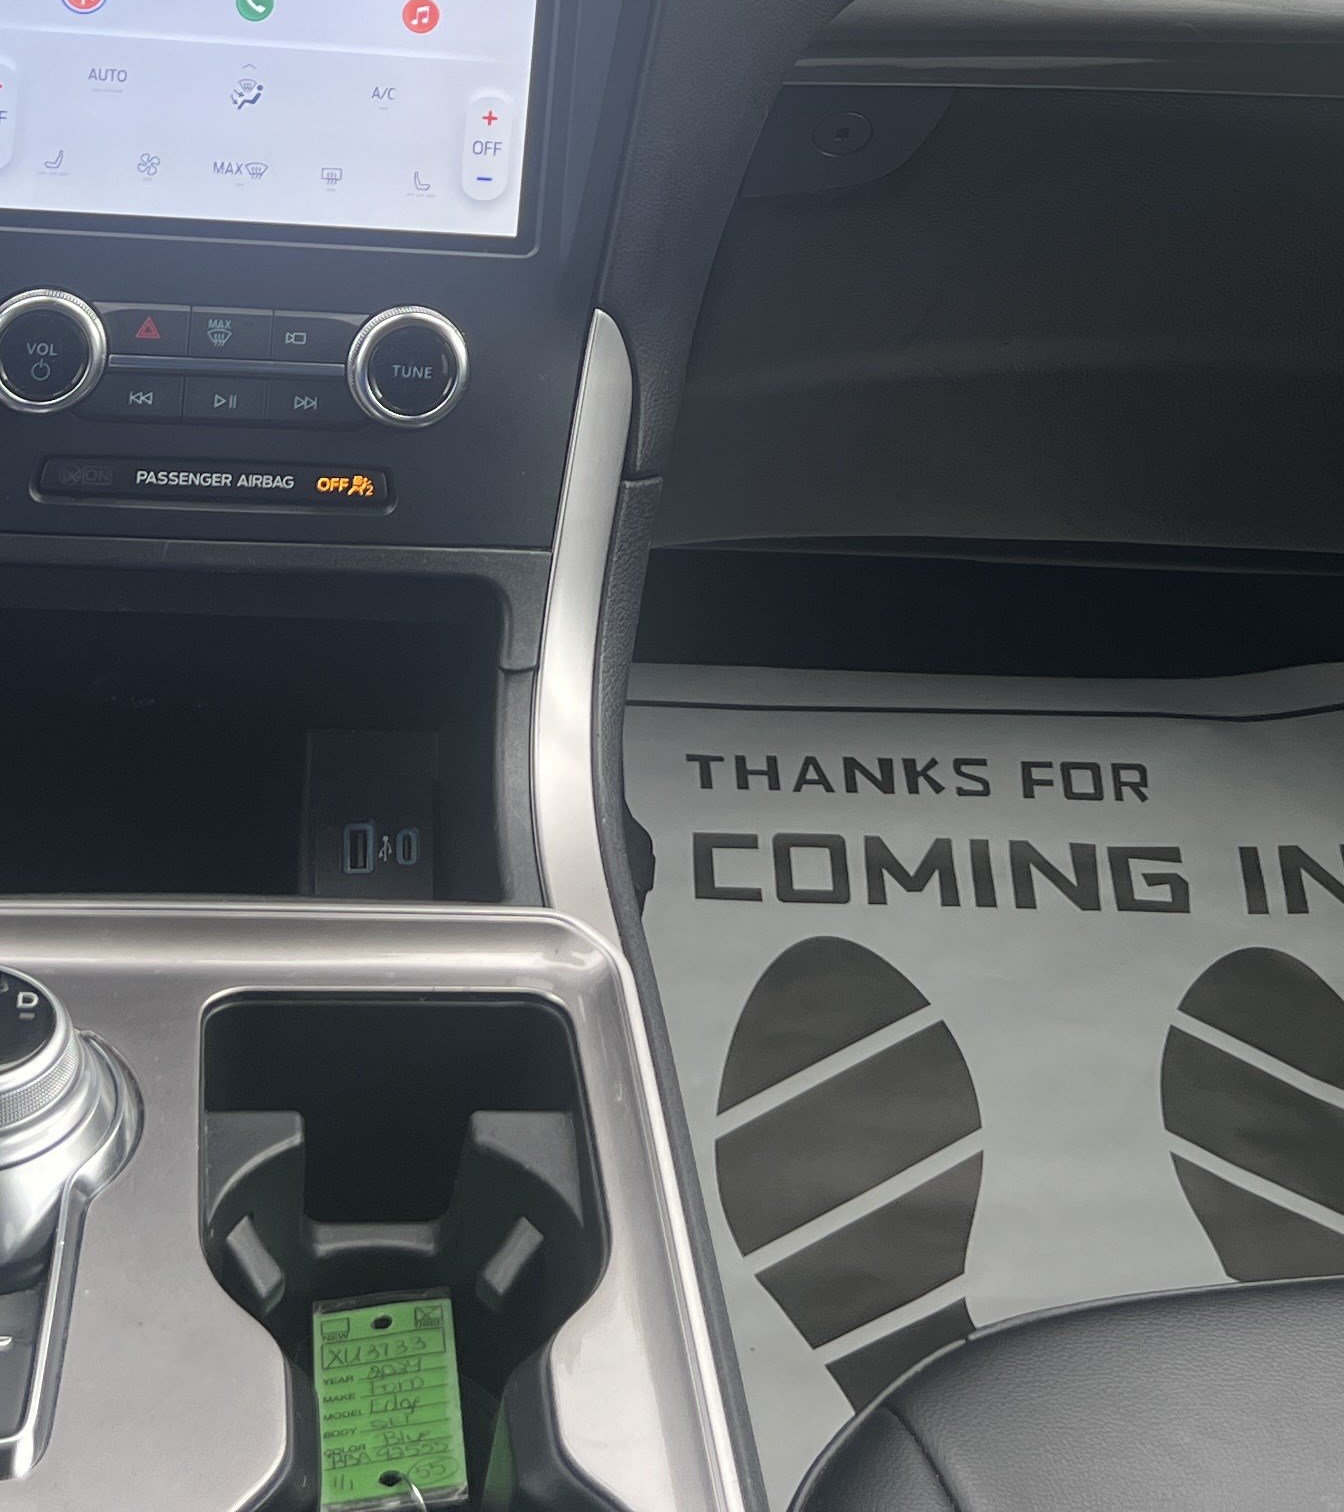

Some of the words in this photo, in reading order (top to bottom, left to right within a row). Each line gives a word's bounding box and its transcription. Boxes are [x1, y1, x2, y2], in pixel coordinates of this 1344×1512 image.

[86, 67, 129, 84] AUTO
[371, 86, 397, 102] A/C
[471, 139, 503, 158] OFF
[212, 160, 244, 177] MAX
[207, 319, 232, 330] MAX
[26, 342, 58, 356] VOL
[392, 364, 433, 380] TUNE
[136, 470, 233, 488] PASSENGER
[236, 474, 295, 489] AIRBAG
[316, 476, 349, 492] OFF
[686, 753, 992, 797] THANKS
[1020, 761, 1150, 803] FOR
[692, 832, 1191, 915] COMING
[16, 991, 40, 1009] D
[323, 1375, 354, 1386] YEAR
[323, 1393, 356, 1403] MAKE
[323, 1410, 362, 1421] MODEL
[323, 1428, 357, 1439] BODY
[324, 1443, 366, 1458] COLOR
